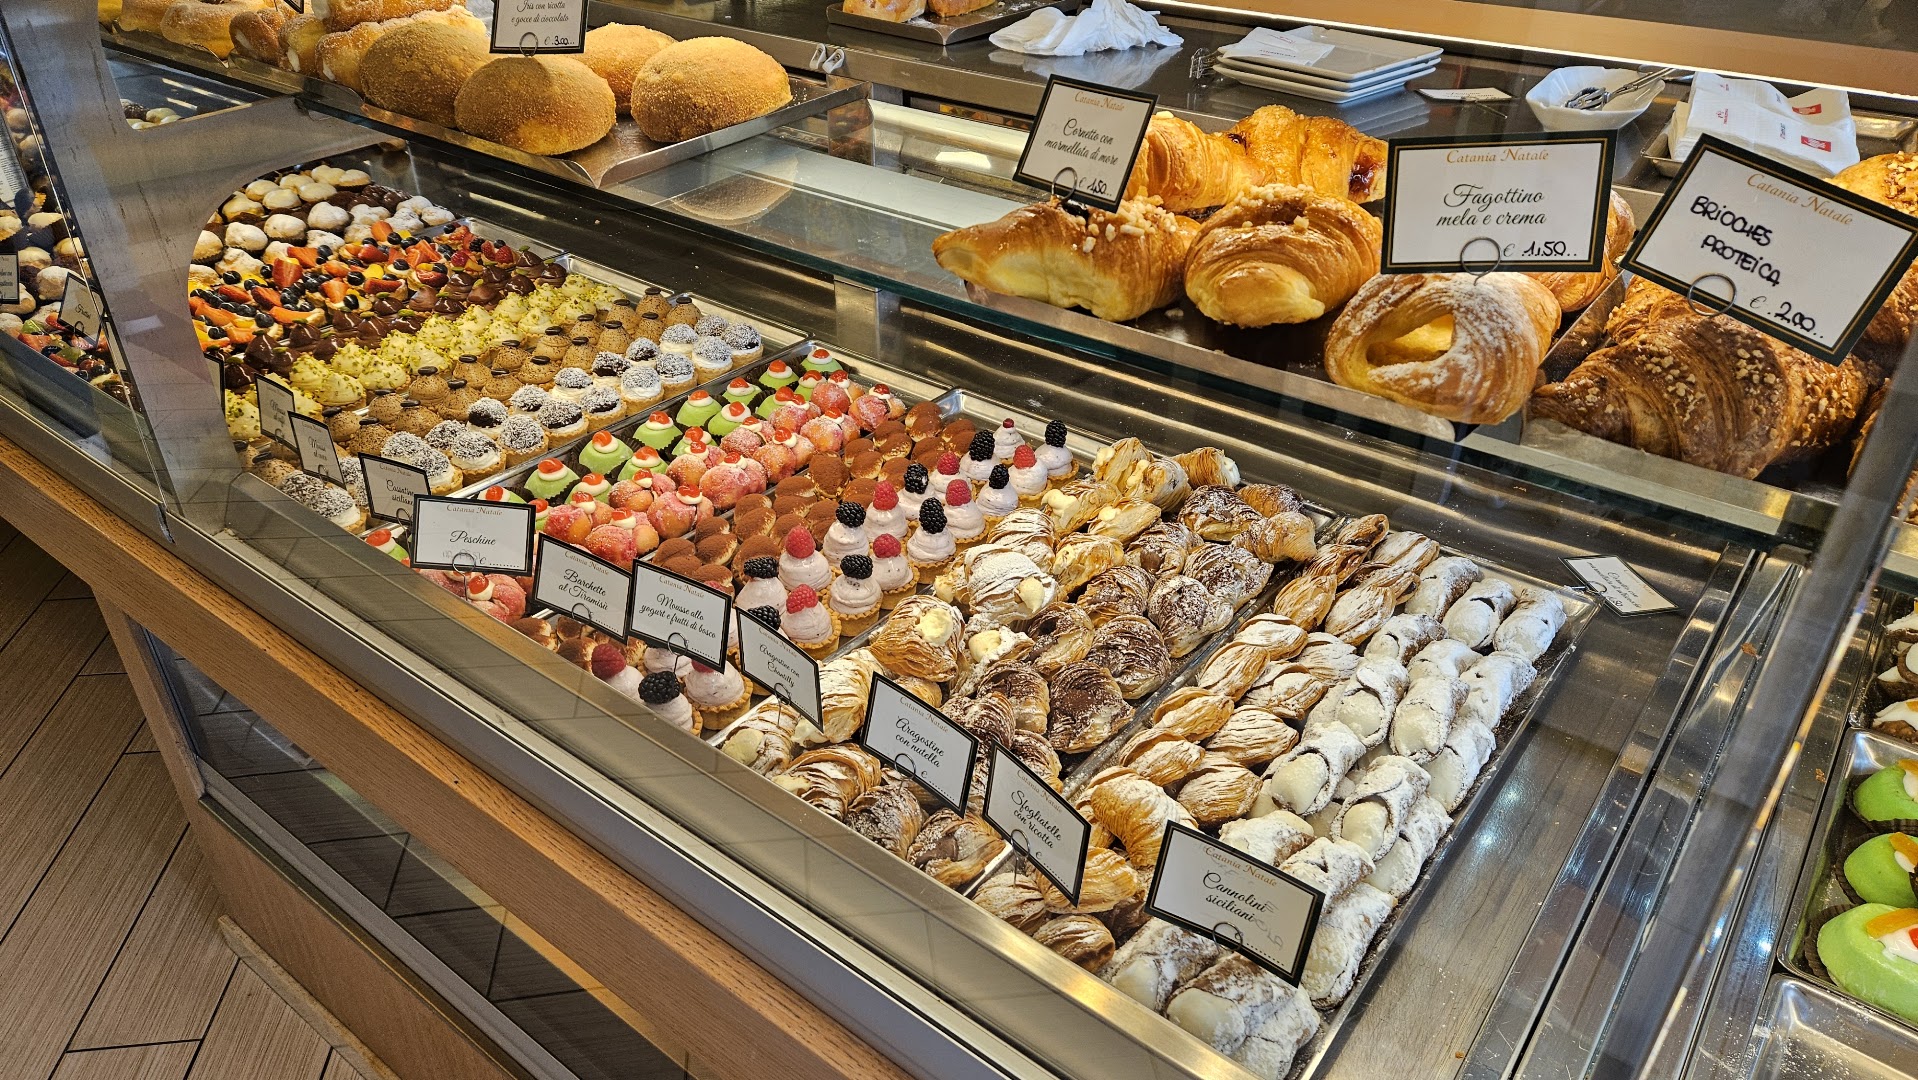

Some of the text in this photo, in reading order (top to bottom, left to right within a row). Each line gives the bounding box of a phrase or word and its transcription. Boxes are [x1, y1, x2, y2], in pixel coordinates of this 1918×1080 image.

[547, 1, 566, 10] ricotta
[514, 16, 532, 27] gocce
[533, 13, 540, 23] di
[541, 13, 569, 23] cioccolato
[1074, 91, 1125, 112] Catania Natale
[1063, 118, 1114, 145] Cornetto con
[1044, 139, 1118, 165] marmellata di more
[1446, 148, 1550, 164] Catania Natale
[1443, 183, 1544, 213] Fagottino
[1747, 173, 1853, 226] Catania Natale
[1436, 208, 1547, 226] mela e crema
[1503, 243, 1516, 258] €
[1749, 295, 1767, 310] €
[446, 504, 503, 516] Catania Natale
[449, 530, 497, 546] Peschine
[558, 583, 569, 592] al
[563, 568, 606, 597] Barchette
[656, 593, 704, 621] Mousse allo
[639, 604, 665, 618] yogurt
[669, 612, 689, 625] frutti
[690, 621, 698, 631] di
[698, 625, 716, 639] bosco
[895, 716, 945, 757] Aragostine
[895, 734, 941, 768] con nutella
[1011, 790, 1062, 841] Sfogliatelle
[1013, 809, 1054, 849] con ricotta
[1204, 846, 1242, 870] Catania
[1242, 865, 1278, 887] Natale
[1202, 870, 1267, 913] Cannolini
[1205, 894, 1255, 923] siciliani
